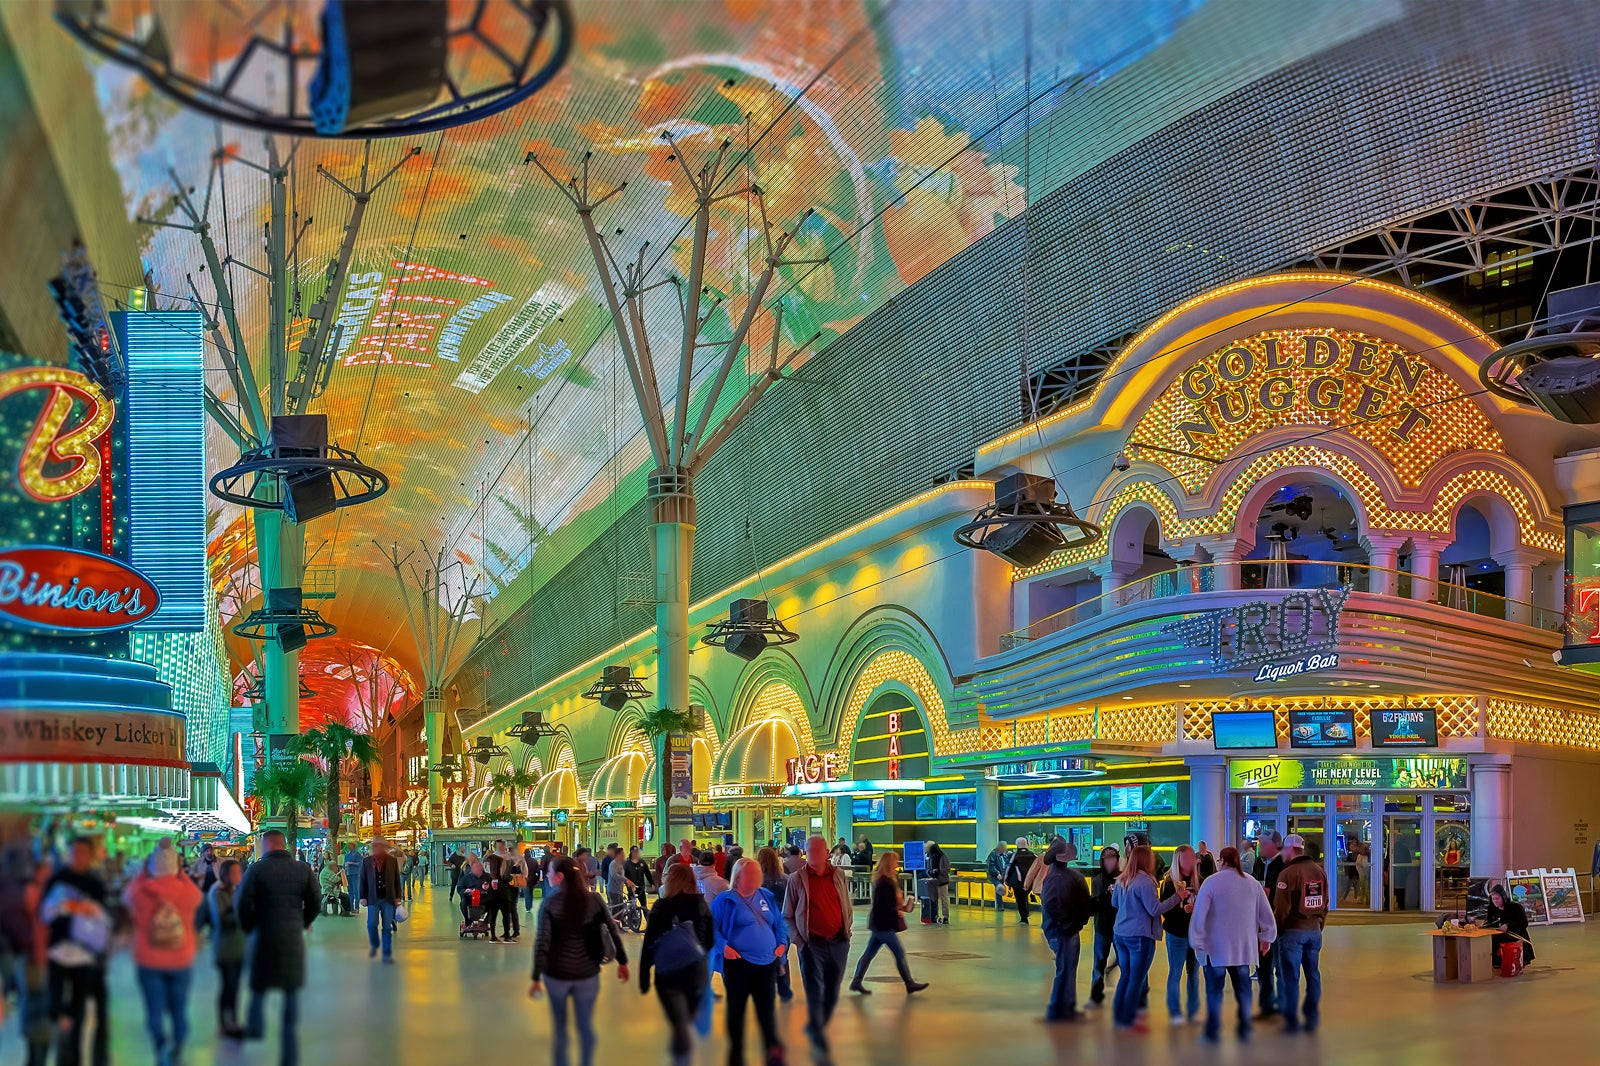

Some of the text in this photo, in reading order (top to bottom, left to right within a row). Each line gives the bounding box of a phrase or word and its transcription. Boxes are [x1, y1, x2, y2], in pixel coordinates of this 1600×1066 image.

[342, 260, 497, 369] PARTY
[438, 290, 514, 362] DOWNTOWN
[466, 299, 543, 376] FOR TICKET INFORMATION
[1181, 335, 1430, 401] GOLDEN
[1175, 375, 1432, 453] NUGGET
[0, 560, 147, 616] Binion's
[1159, 583, 1354, 666] TROY
[1254, 652, 1339, 684] Liquor Bar
[13, 718, 107, 746] Whiskey
[114, 723, 165, 746] Licker
[888, 712, 899, 780] BAR
[1235, 761, 1281, 783] TROY
[1311, 768, 1381, 778] THE NEXT LEVEL
